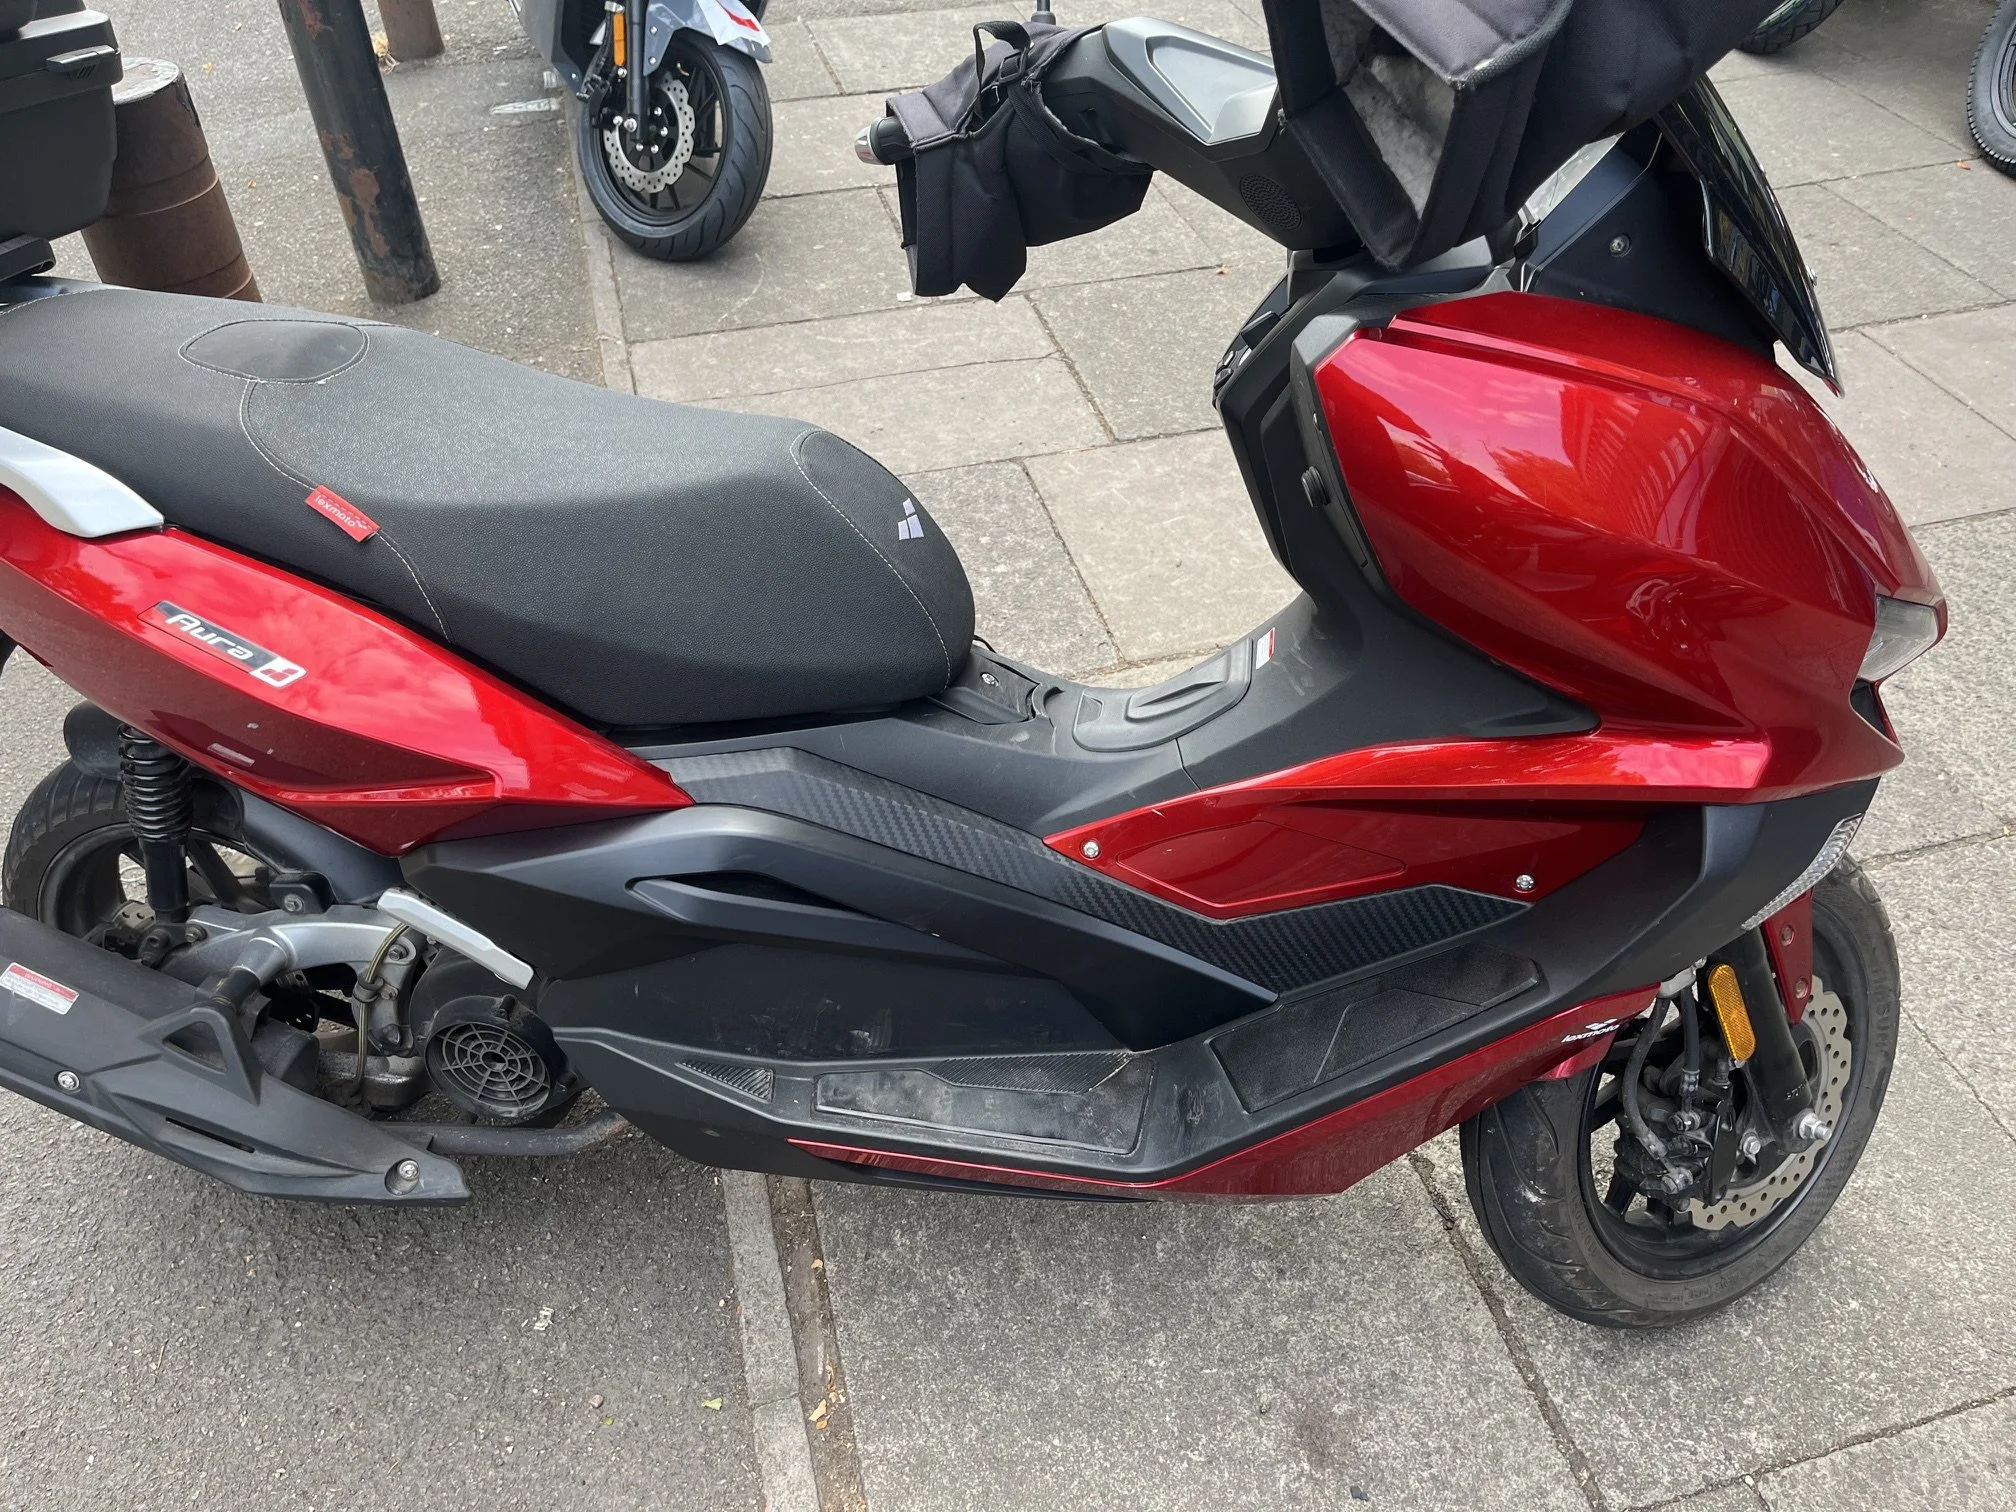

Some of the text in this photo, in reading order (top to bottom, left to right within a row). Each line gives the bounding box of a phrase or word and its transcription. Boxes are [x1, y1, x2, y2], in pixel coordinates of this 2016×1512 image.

[314, 493, 356, 528] lexmoto
[165, 613, 254, 660] Aura
[1561, 1024, 1620, 1043] lexmoto
